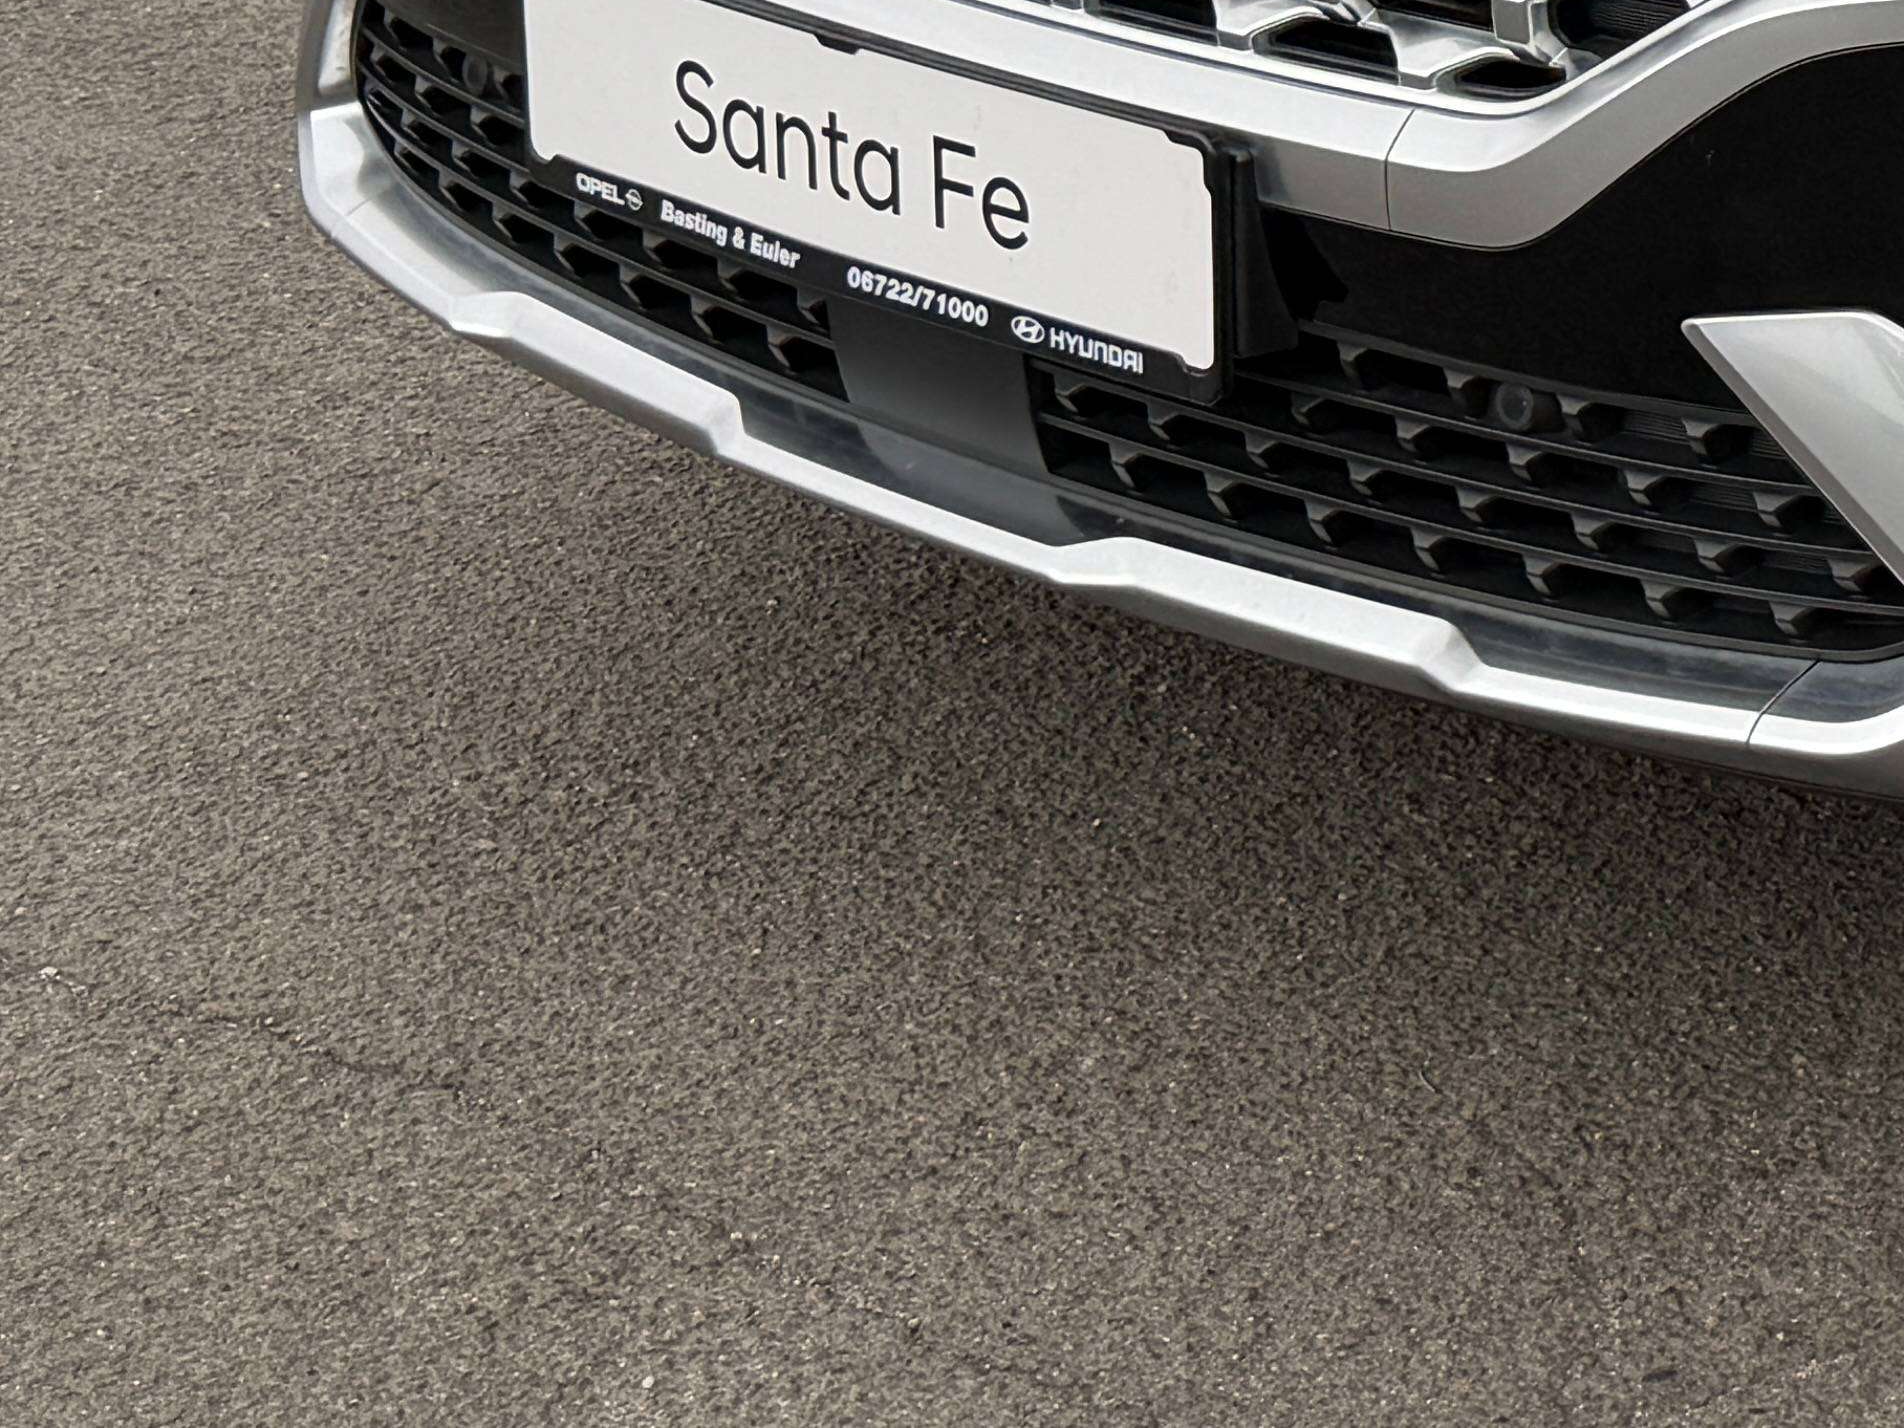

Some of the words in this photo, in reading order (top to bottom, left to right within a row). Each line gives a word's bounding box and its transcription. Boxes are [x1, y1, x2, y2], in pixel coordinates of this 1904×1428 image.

[674, 59, 902, 216] Santa
[932, 135, 1030, 250] Fe
[576, 172, 626, 206] OPEL
[661, 199, 728, 247] Basting
[733, 226, 746, 250] &
[750, 232, 801, 269] Euler
[847, 266, 990, 328] 06722/71000
[1049, 326, 1145, 374] HYUNDAI
